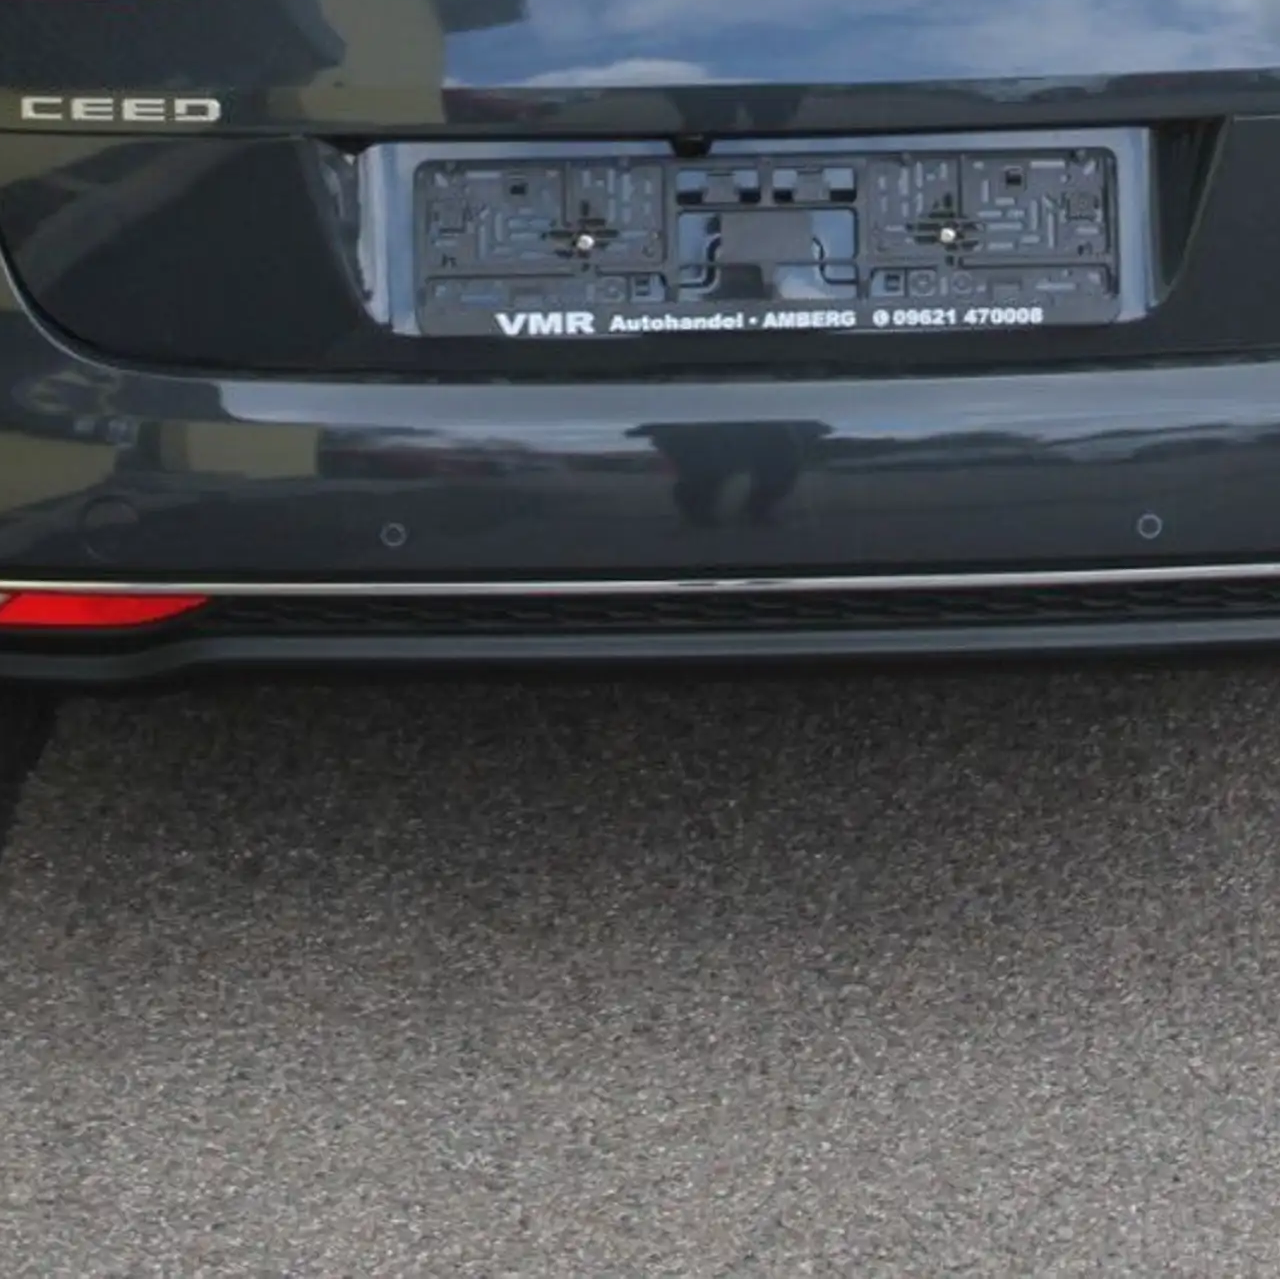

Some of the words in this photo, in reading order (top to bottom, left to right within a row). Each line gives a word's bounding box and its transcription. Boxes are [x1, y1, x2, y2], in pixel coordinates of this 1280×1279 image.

[21, 97, 221, 121] CEED
[495, 311, 595, 335] VMR
[609, 312, 744, 332] Autohandel
[762, 310, 856, 328] AMBERG
[892, 308, 956, 326] 09621
